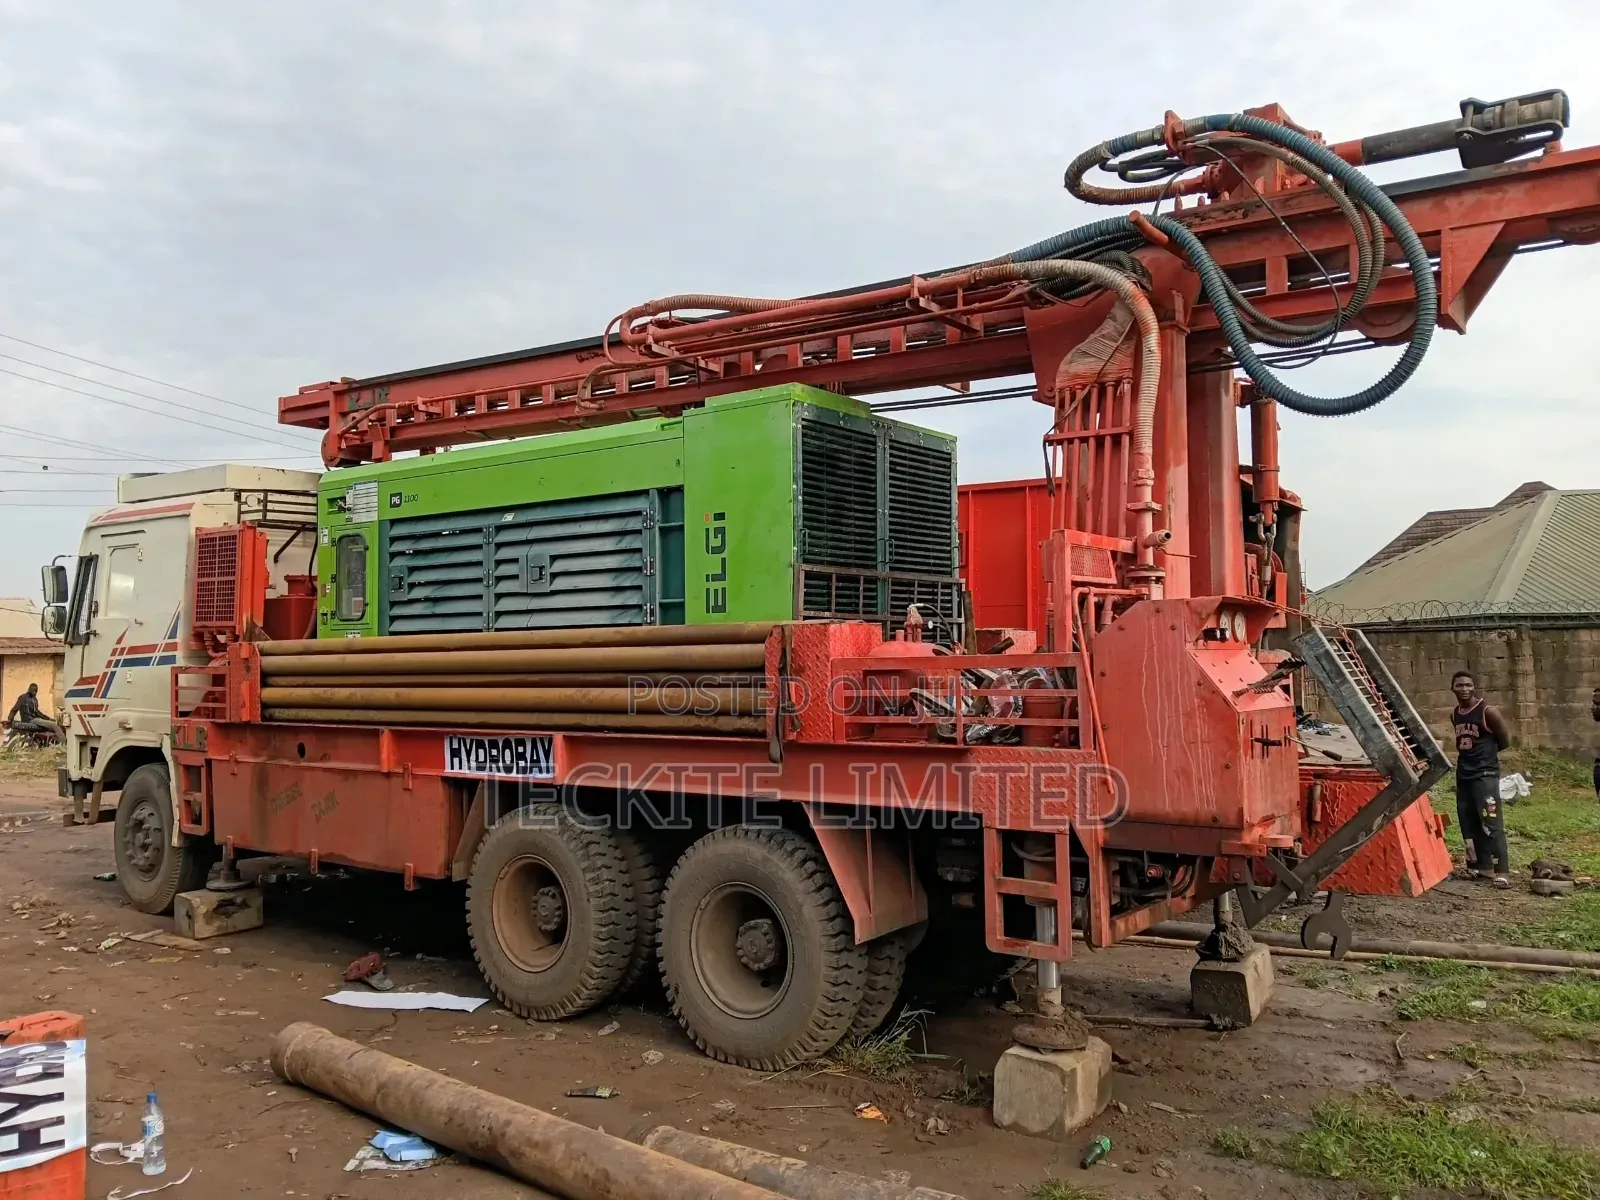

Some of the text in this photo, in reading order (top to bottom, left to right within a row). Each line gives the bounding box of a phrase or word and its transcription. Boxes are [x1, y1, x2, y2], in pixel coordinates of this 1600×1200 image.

[391, 494, 419, 505] PG 1100
[449, 734, 553, 775] HYDROBAY
